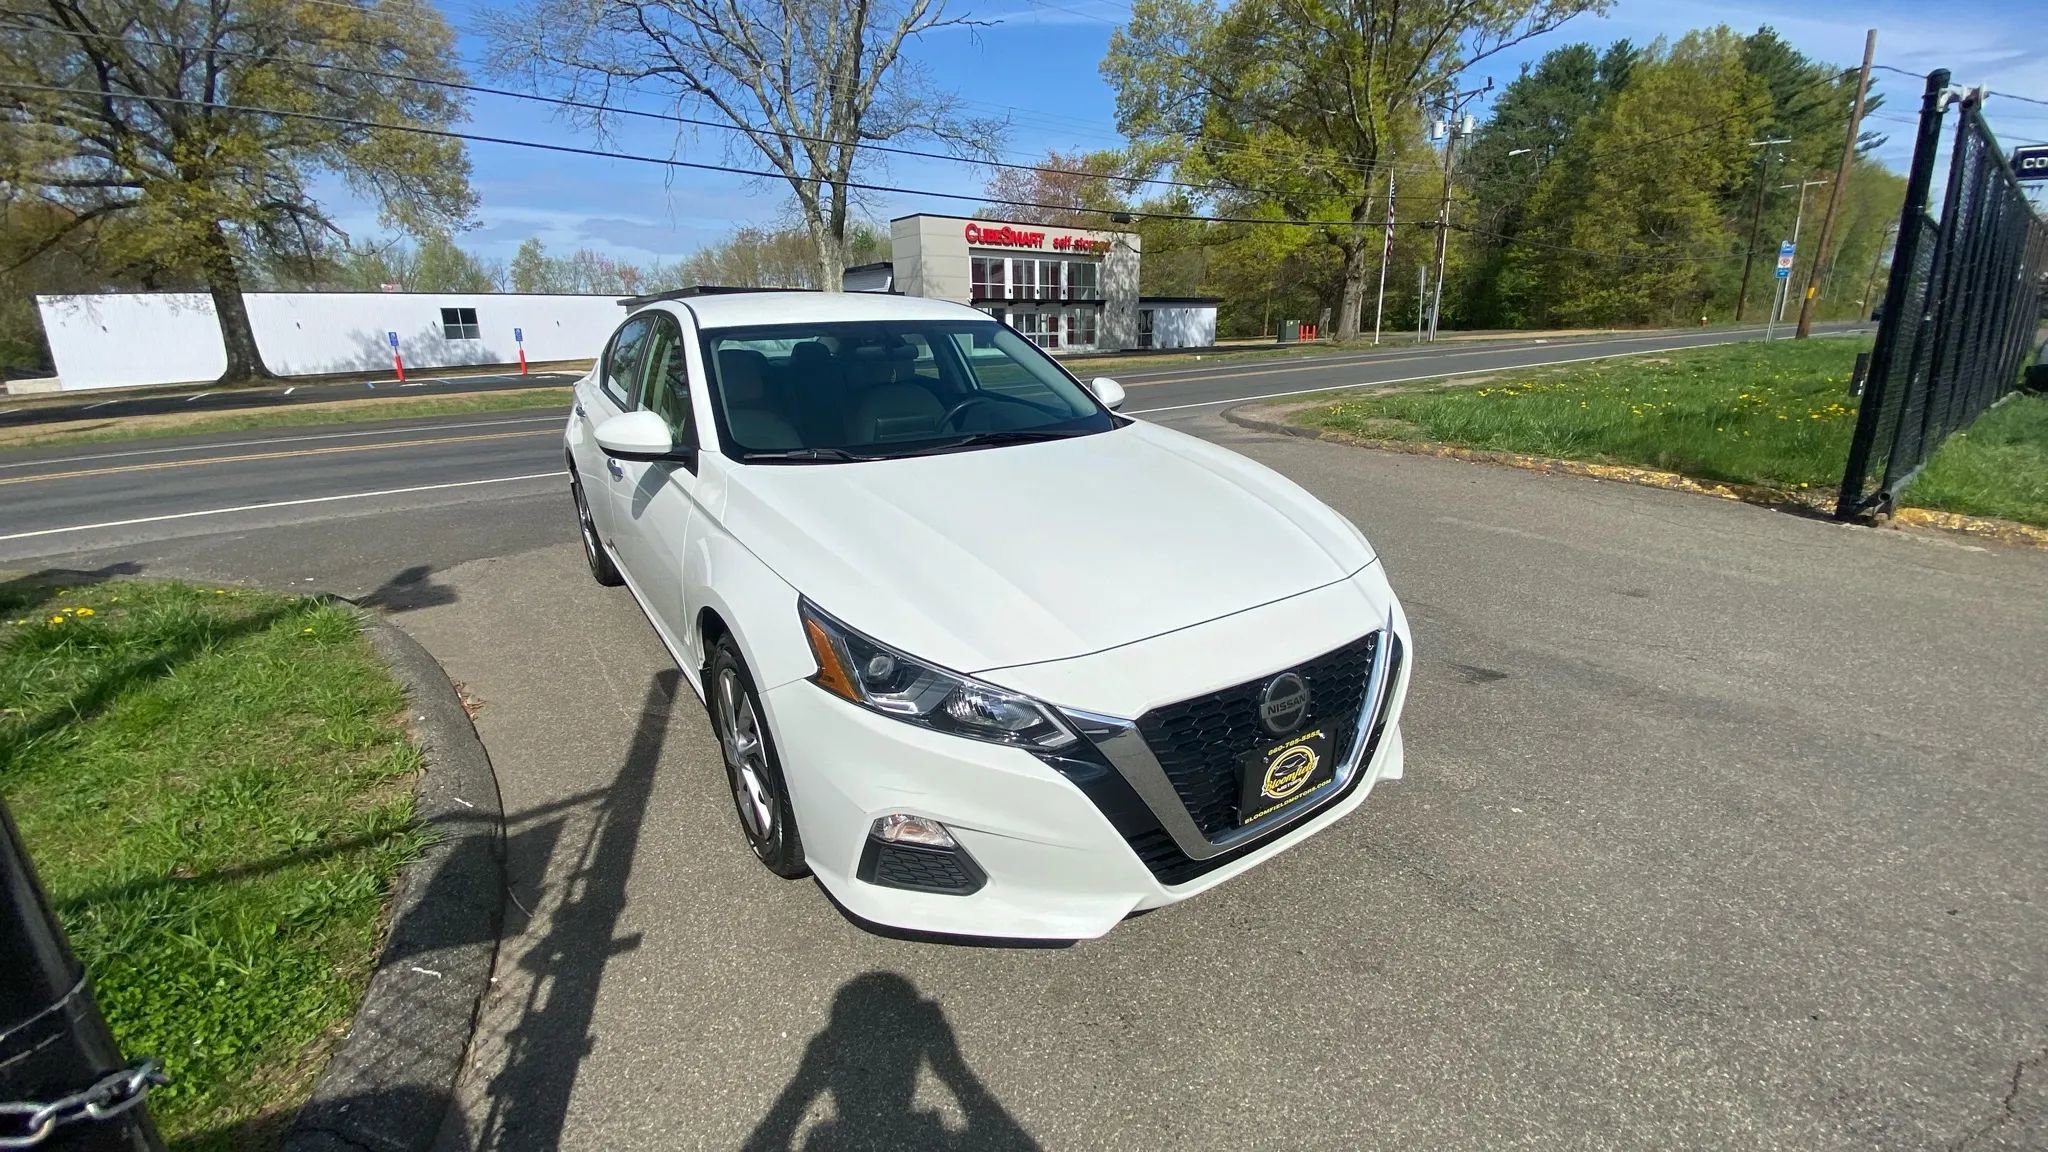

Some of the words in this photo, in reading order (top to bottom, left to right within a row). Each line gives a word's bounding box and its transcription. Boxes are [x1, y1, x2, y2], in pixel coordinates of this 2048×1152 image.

[1267, 692, 1306, 716] NISSAN
[1265, 761, 1314, 792] Bloomfield
[1244, 778, 1332, 824] BLOOMFIELDMOTORS.COM
